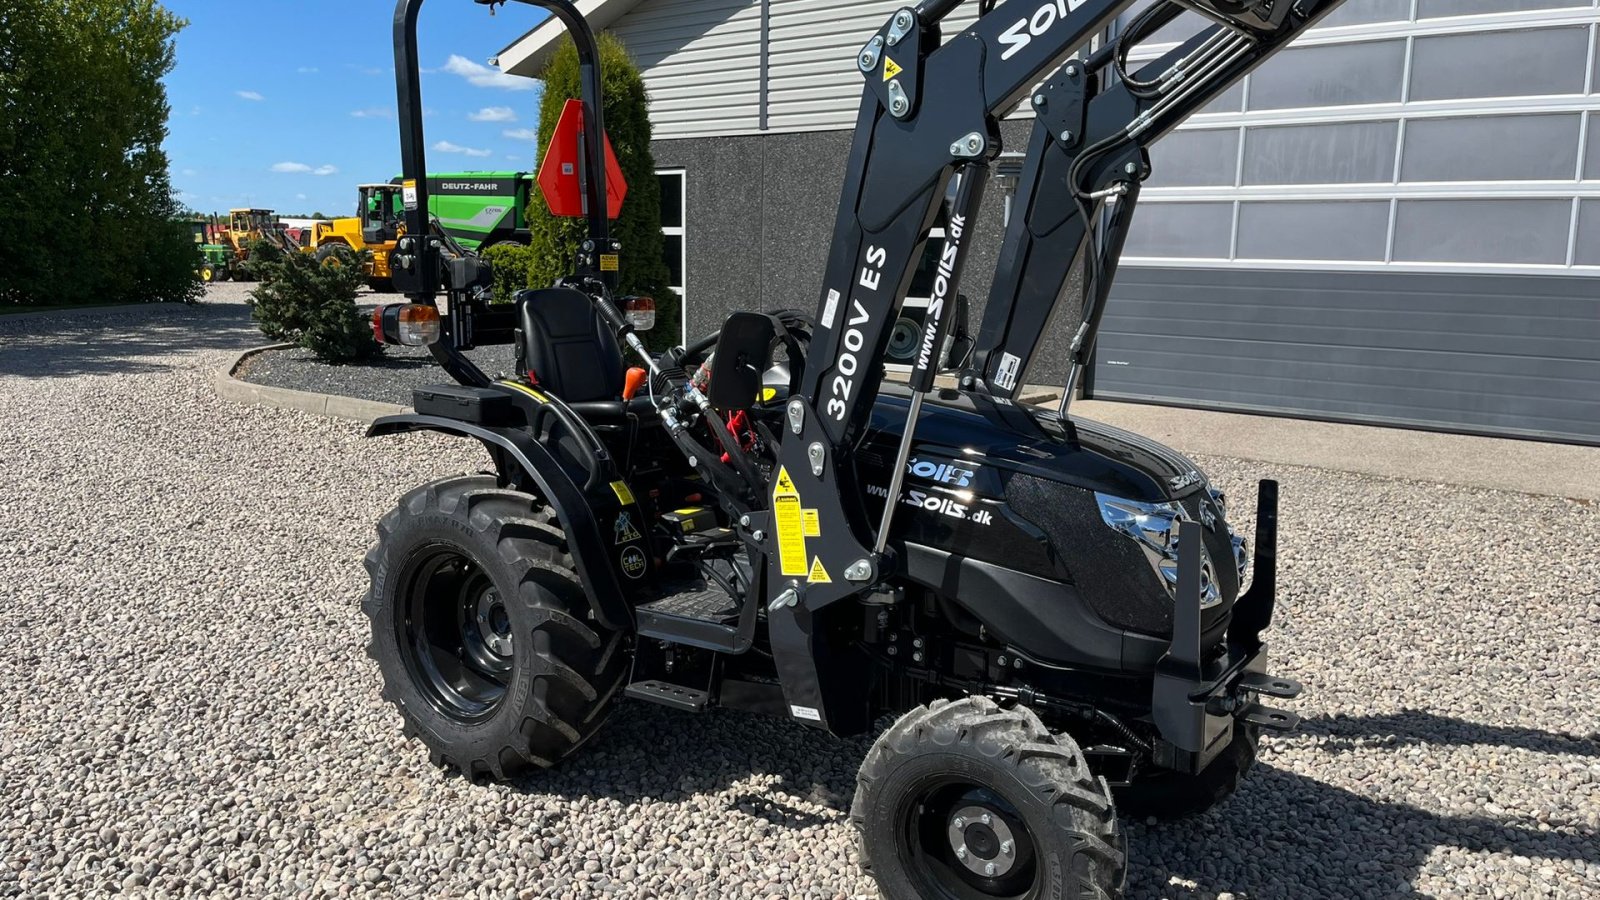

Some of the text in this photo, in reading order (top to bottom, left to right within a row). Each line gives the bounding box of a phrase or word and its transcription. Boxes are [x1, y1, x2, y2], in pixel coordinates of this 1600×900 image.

[827, 299, 870, 421] 3200V
[859, 245, 887, 291] ES
[374, 563, 387, 599] CEAT
[516, 679, 529, 715] CEAT
